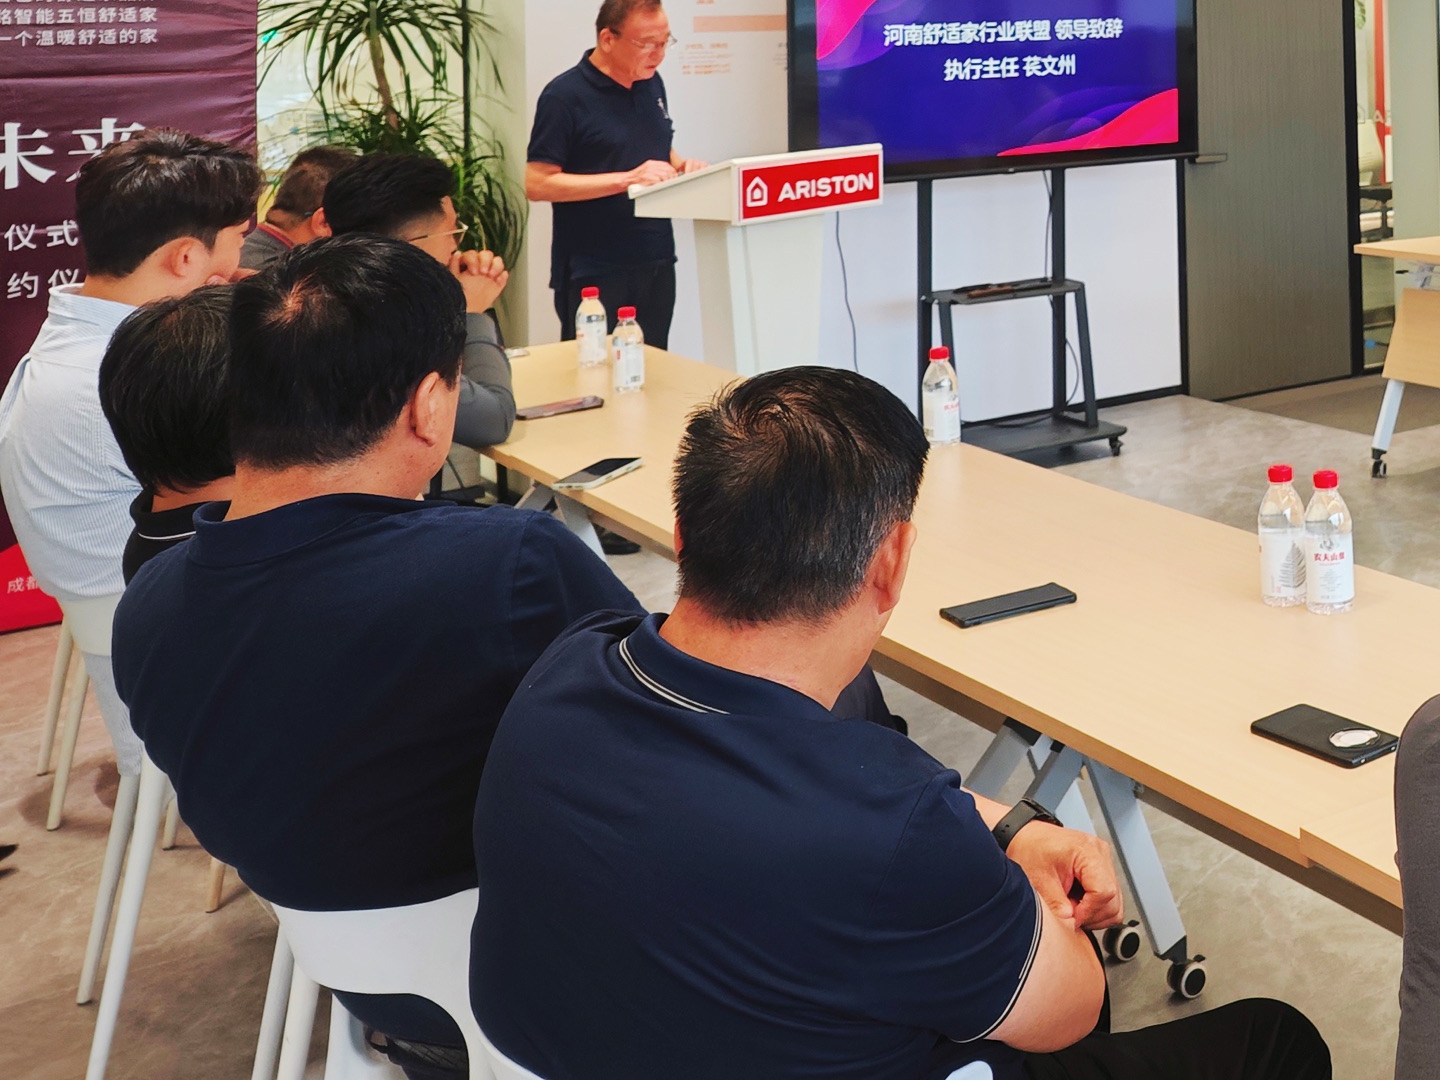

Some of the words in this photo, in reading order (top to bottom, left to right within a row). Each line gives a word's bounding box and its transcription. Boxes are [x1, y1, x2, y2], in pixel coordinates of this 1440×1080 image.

[0, 27, 158, 47] 一个温暖舒适的家
[882, 19, 1052, 47] 河南舒适家行业联盟
[1054, 17, 1124, 41] 领导致辞
[943, 57, 1020, 81] 执行主任
[777, 171, 874, 203] ARISTON
[4, 219, 79, 251] 仪式
